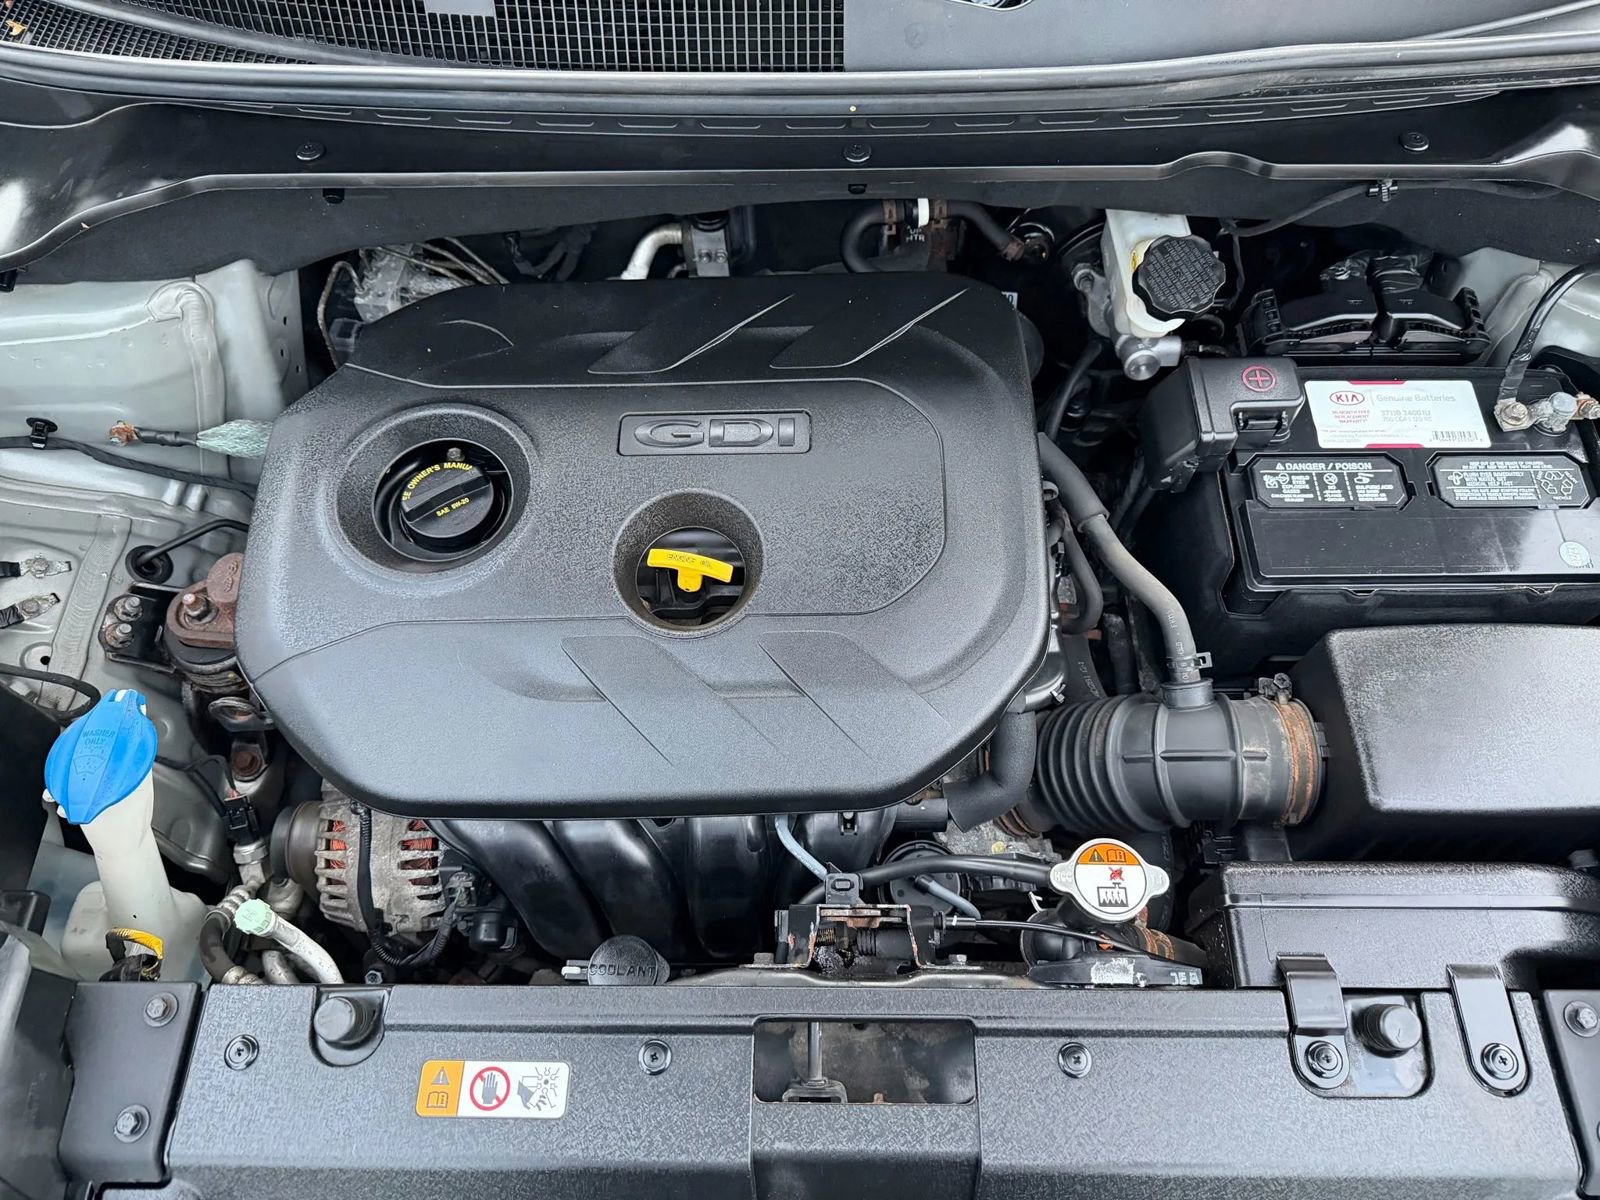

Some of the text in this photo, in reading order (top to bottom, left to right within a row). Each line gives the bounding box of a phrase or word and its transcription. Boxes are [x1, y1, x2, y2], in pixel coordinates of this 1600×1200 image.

[1376, 394, 1457, 402] Genuine Batteries
[634, 418, 795, 448] GDI
[1335, 462, 1372, 470] POISON
[407, 464, 440, 489] OWNER'S
[436, 506, 450, 517] SAE
[82, 729, 116, 738] WASHER
[84, 737, 107, 745] ONLY
[589, 963, 656, 977] COOLANT
